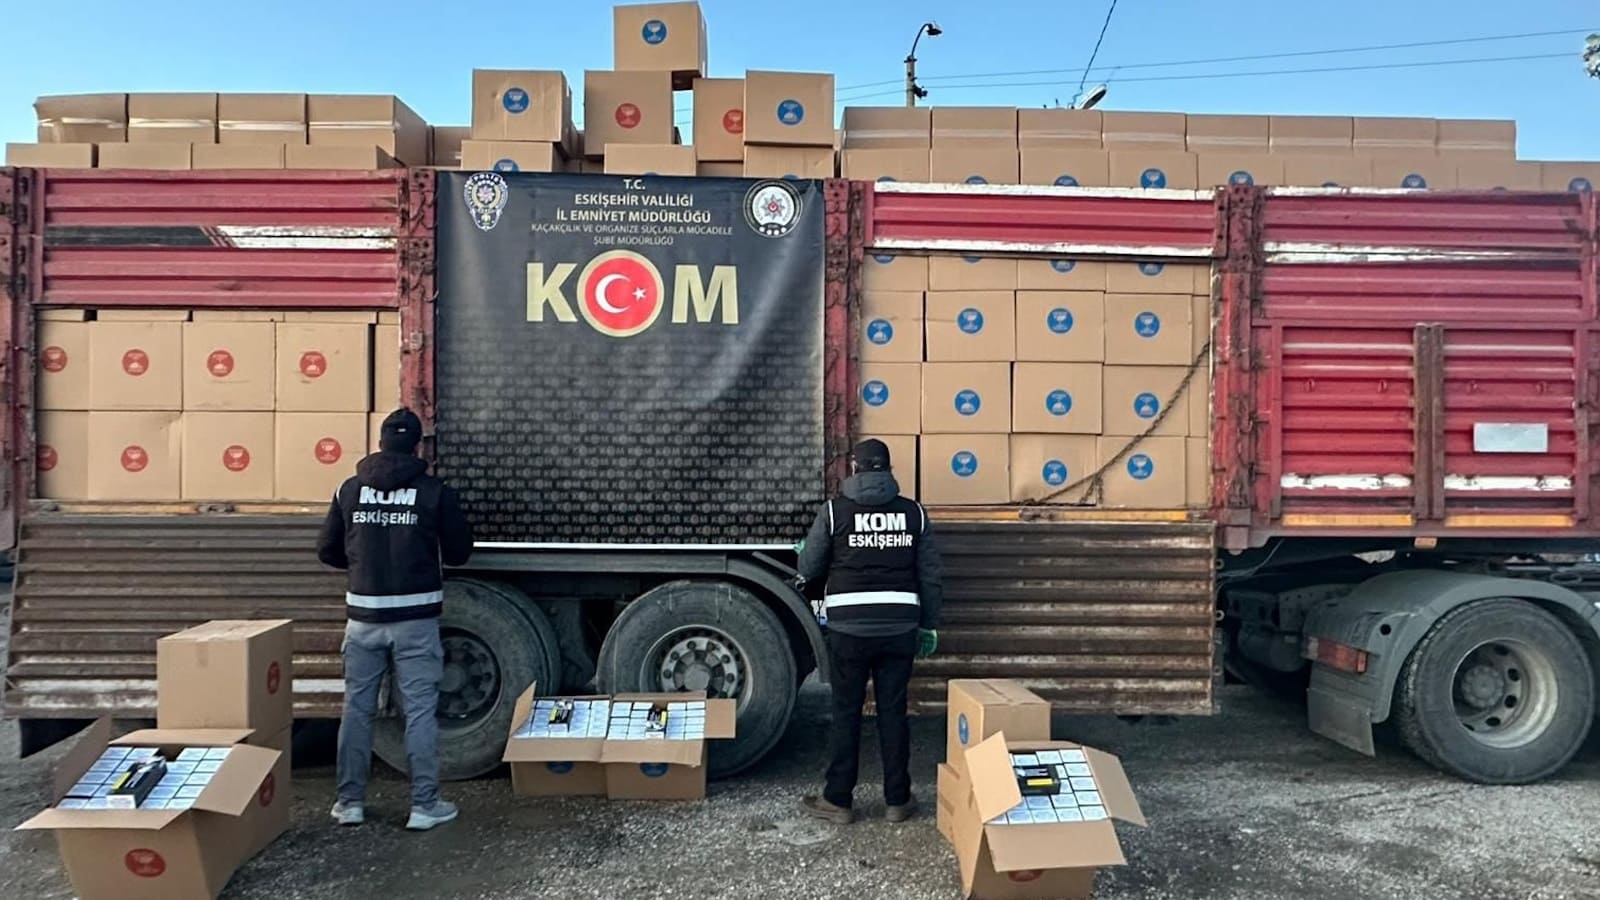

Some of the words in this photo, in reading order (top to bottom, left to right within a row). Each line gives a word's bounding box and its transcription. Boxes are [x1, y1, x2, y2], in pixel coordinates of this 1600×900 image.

[623, 179, 646, 190] T.C.
[575, 191, 639, 208] ESKİŞEHİR
[641, 192, 694, 207] VALİLİĞİ
[556, 208, 568, 221] İL
[570, 208, 626, 222] EMNİYET
[629, 209, 711, 224] MÜDÜRLÜĞÜ
[531, 222, 581, 235] KAÇAKÇILIK
[583, 224, 594, 233] VE
[595, 223, 640, 234] ORGANİZE
[641, 224, 685, 236] SUÇLARLA
[687, 226, 733, 235] MÜCADELE
[594, 237, 617, 246] ŞUBE
[618, 236, 674, 246] MÜDÜRLÜĞÜ
[352, 510, 418, 526] ESKİŞEHİR
[854, 513, 906, 532] KOM
[848, 531, 913, 550] ESKİŞEHİR
